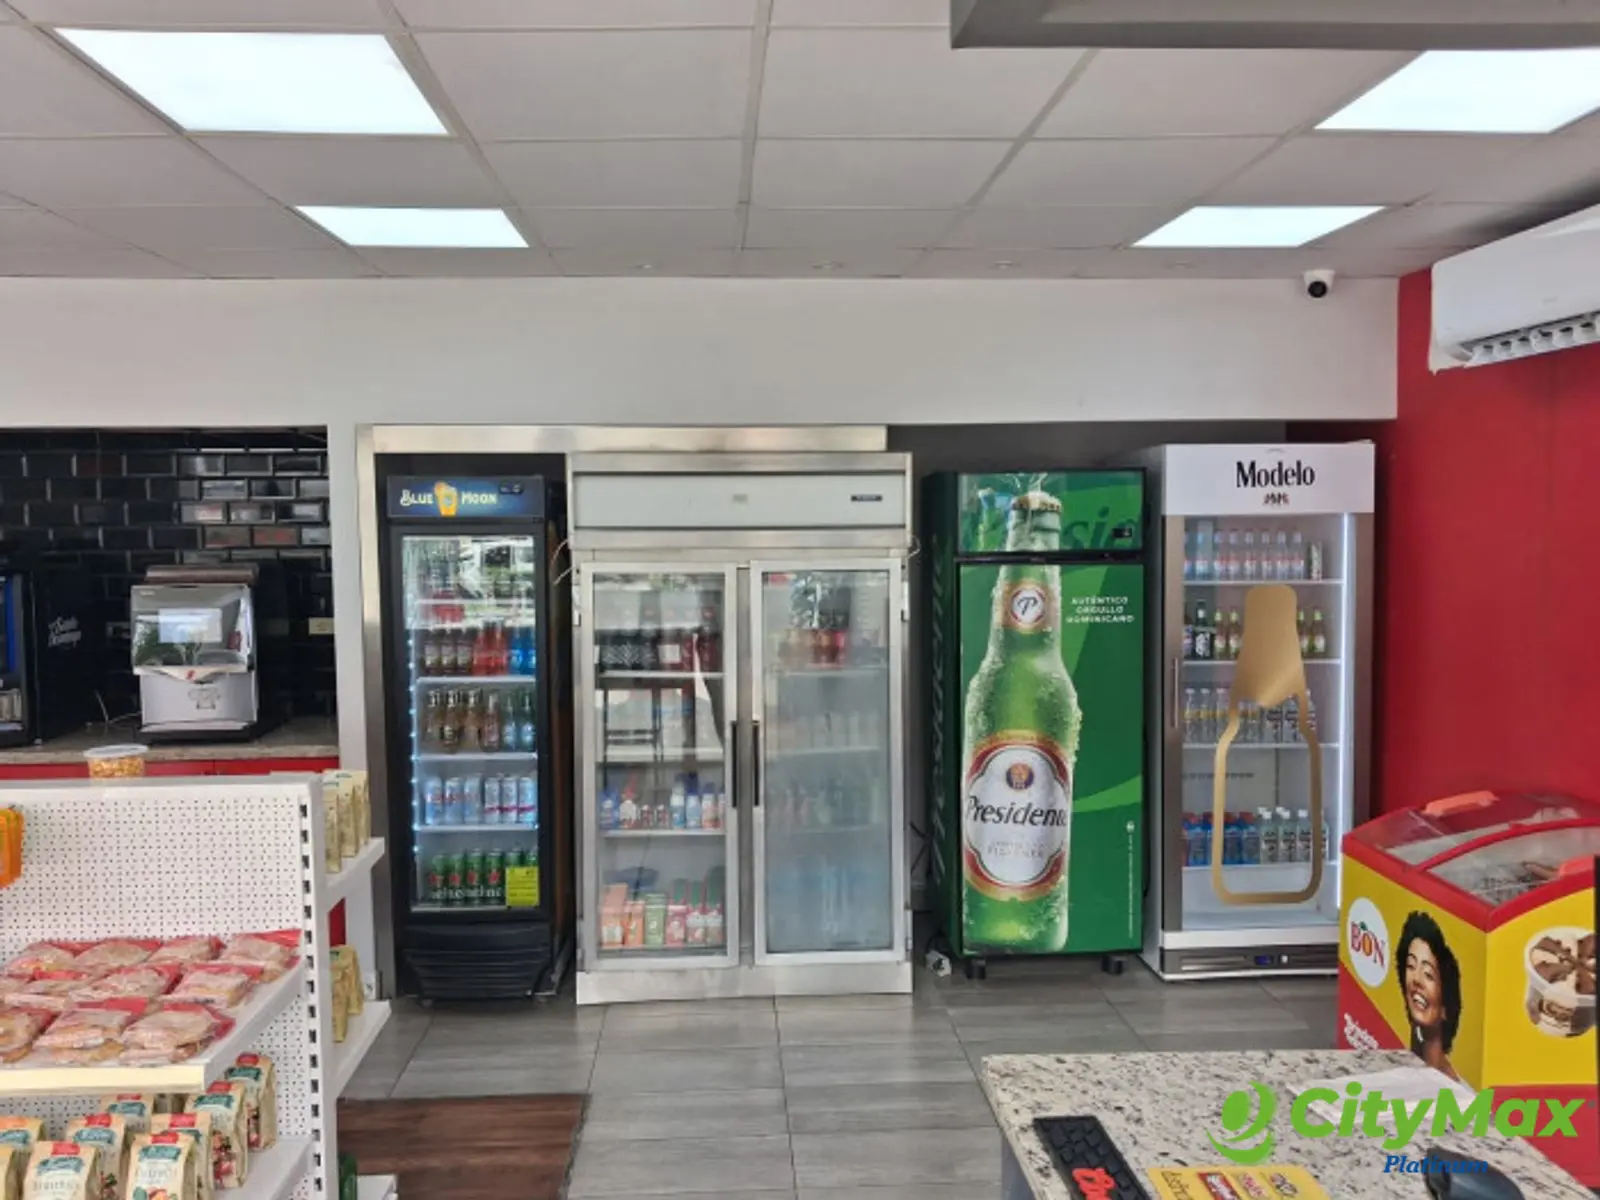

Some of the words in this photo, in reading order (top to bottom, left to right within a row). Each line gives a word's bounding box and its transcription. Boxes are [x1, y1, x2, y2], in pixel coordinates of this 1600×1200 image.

[1236, 460, 1315, 488] Modelo
[461, 491, 497, 505] MOON
[1351, 920, 1386, 967] BON
